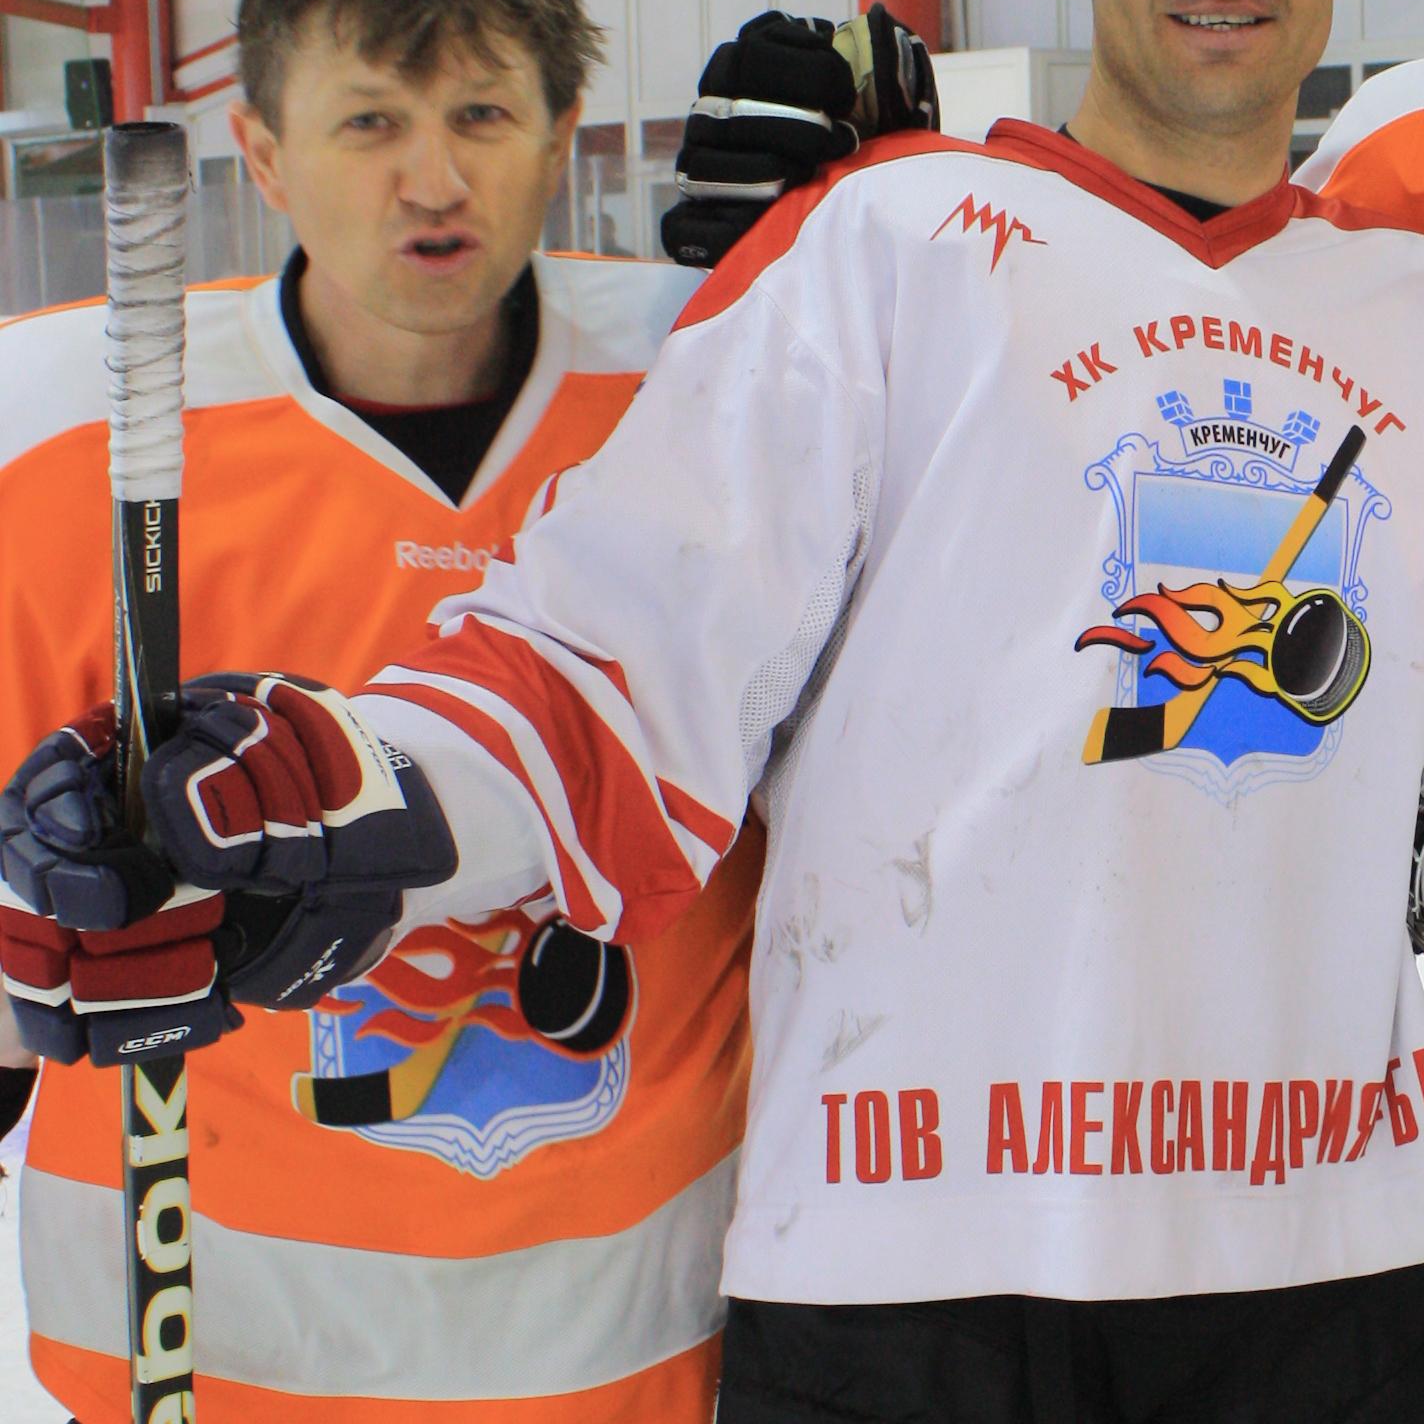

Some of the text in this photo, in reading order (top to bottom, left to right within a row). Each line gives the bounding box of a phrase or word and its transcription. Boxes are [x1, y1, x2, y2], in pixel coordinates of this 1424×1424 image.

[1050, 314, 1406, 435] ХК КРЕМЕНЧУГ
[1190, 424, 1291, 460] КРЕМЕНЧУГ
[395, 541, 499, 572] Reebo
[276, 938, 343, 1001] VECTOR
[122, 1029, 186, 1051] CCM
[821, 1087, 943, 1184] ТОВ
